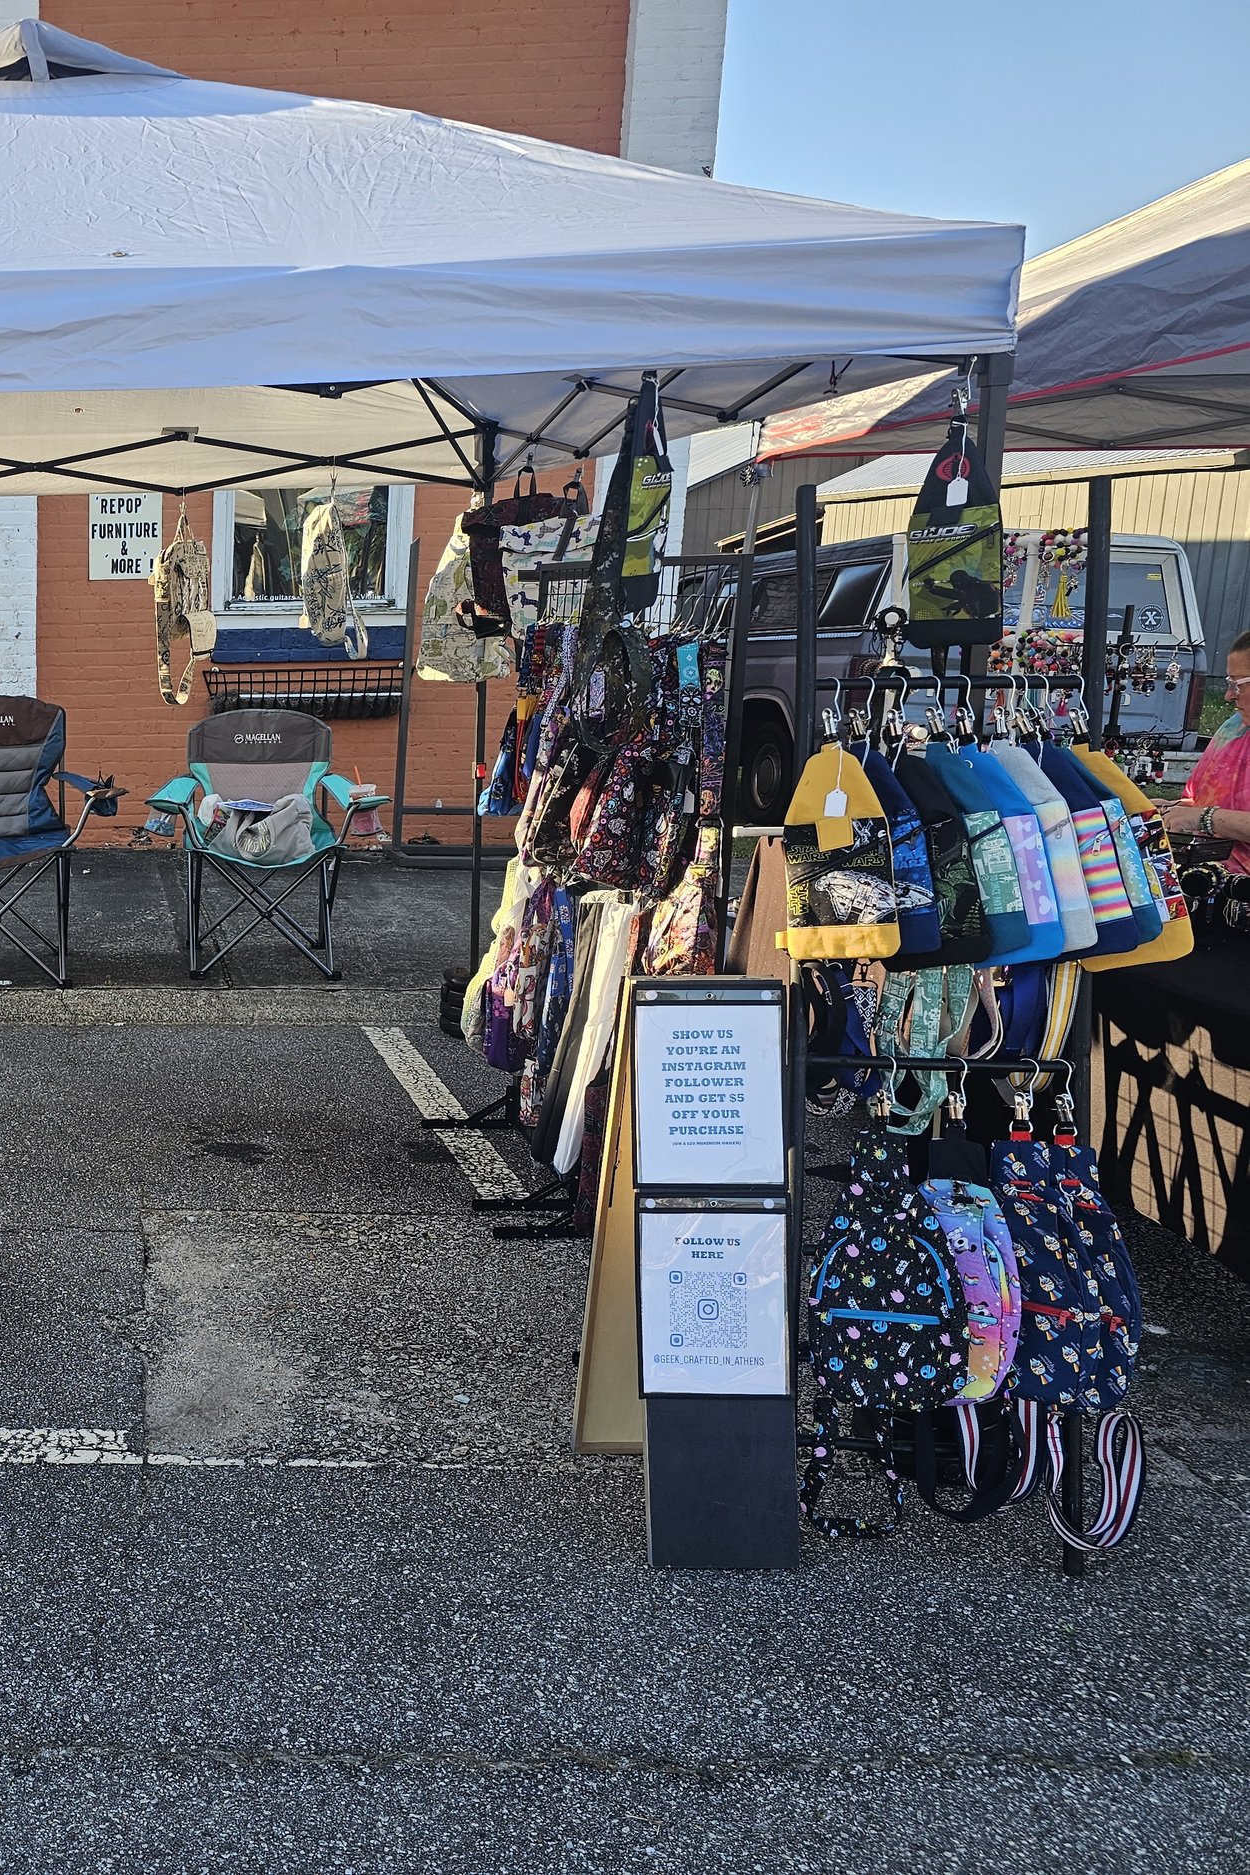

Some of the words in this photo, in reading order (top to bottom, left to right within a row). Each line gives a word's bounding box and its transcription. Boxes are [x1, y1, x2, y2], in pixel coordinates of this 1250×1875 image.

[100, 497, 142, 514] REPOP
[91, 522, 158, 539] FURNITURE
[120, 540, 128, 556] &
[111, 558, 142, 575] MORE
[245, 733, 281, 742] MAGELLAN
[672, 1030, 714, 1040] SHOW
[717, 1029, 733, 1039] US
[666, 1046, 718, 1056] YOU'RE
[721, 1045, 741, 1055] AN
[661, 1061, 747, 1072] INSTAGRAM
[664, 1077, 745, 1088] FOLLOWER
[664, 1094, 695, 1103] AND
[698, 1093, 726, 1103] GET
[671, 1110, 699, 1119] OFF
[701, 1109, 741, 1119] YOUR
[668, 1125, 744, 1136] PURCHASE
[726, 1238, 741, 1247] US
[691, 1251, 724, 1260] HERE
